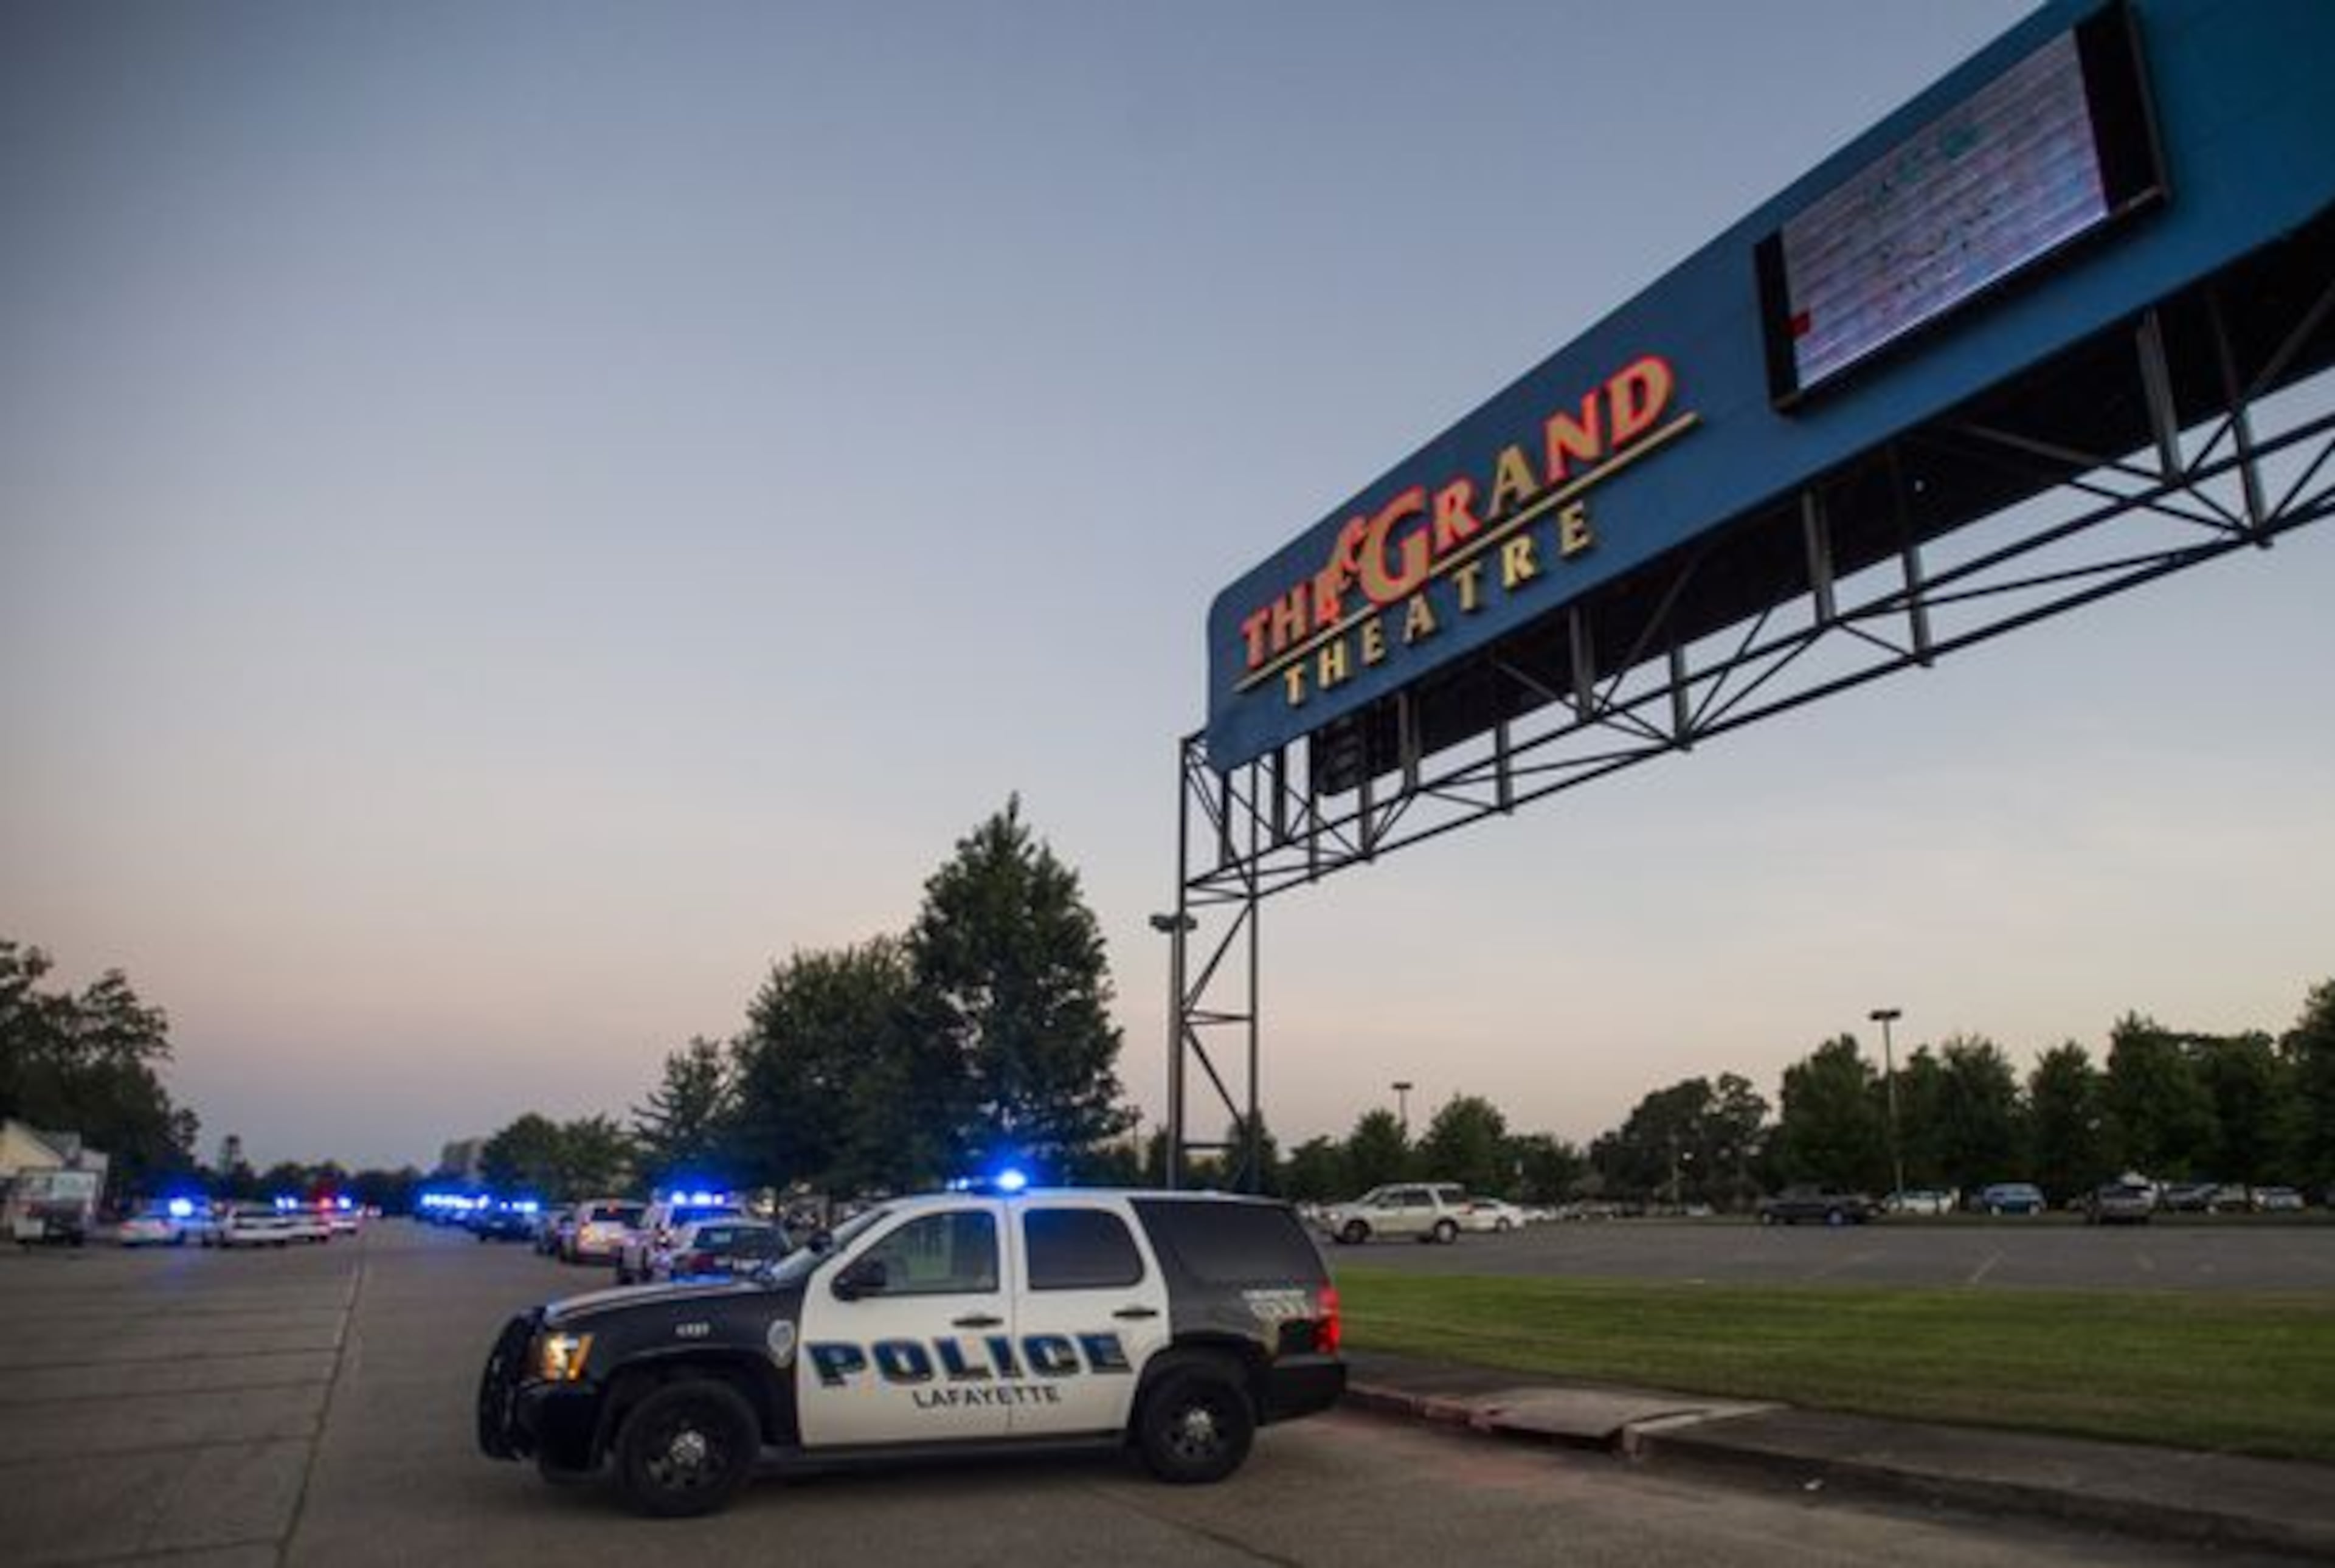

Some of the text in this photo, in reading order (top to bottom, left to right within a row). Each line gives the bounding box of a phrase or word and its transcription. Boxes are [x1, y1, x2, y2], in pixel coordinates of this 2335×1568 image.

[1358, 354, 1675, 606] GRAND
[1284, 500, 1593, 706] THEATRE
[805, 1331, 1133, 1387] POLICE
[912, 1385, 1061, 1409] LAFAYETTE
